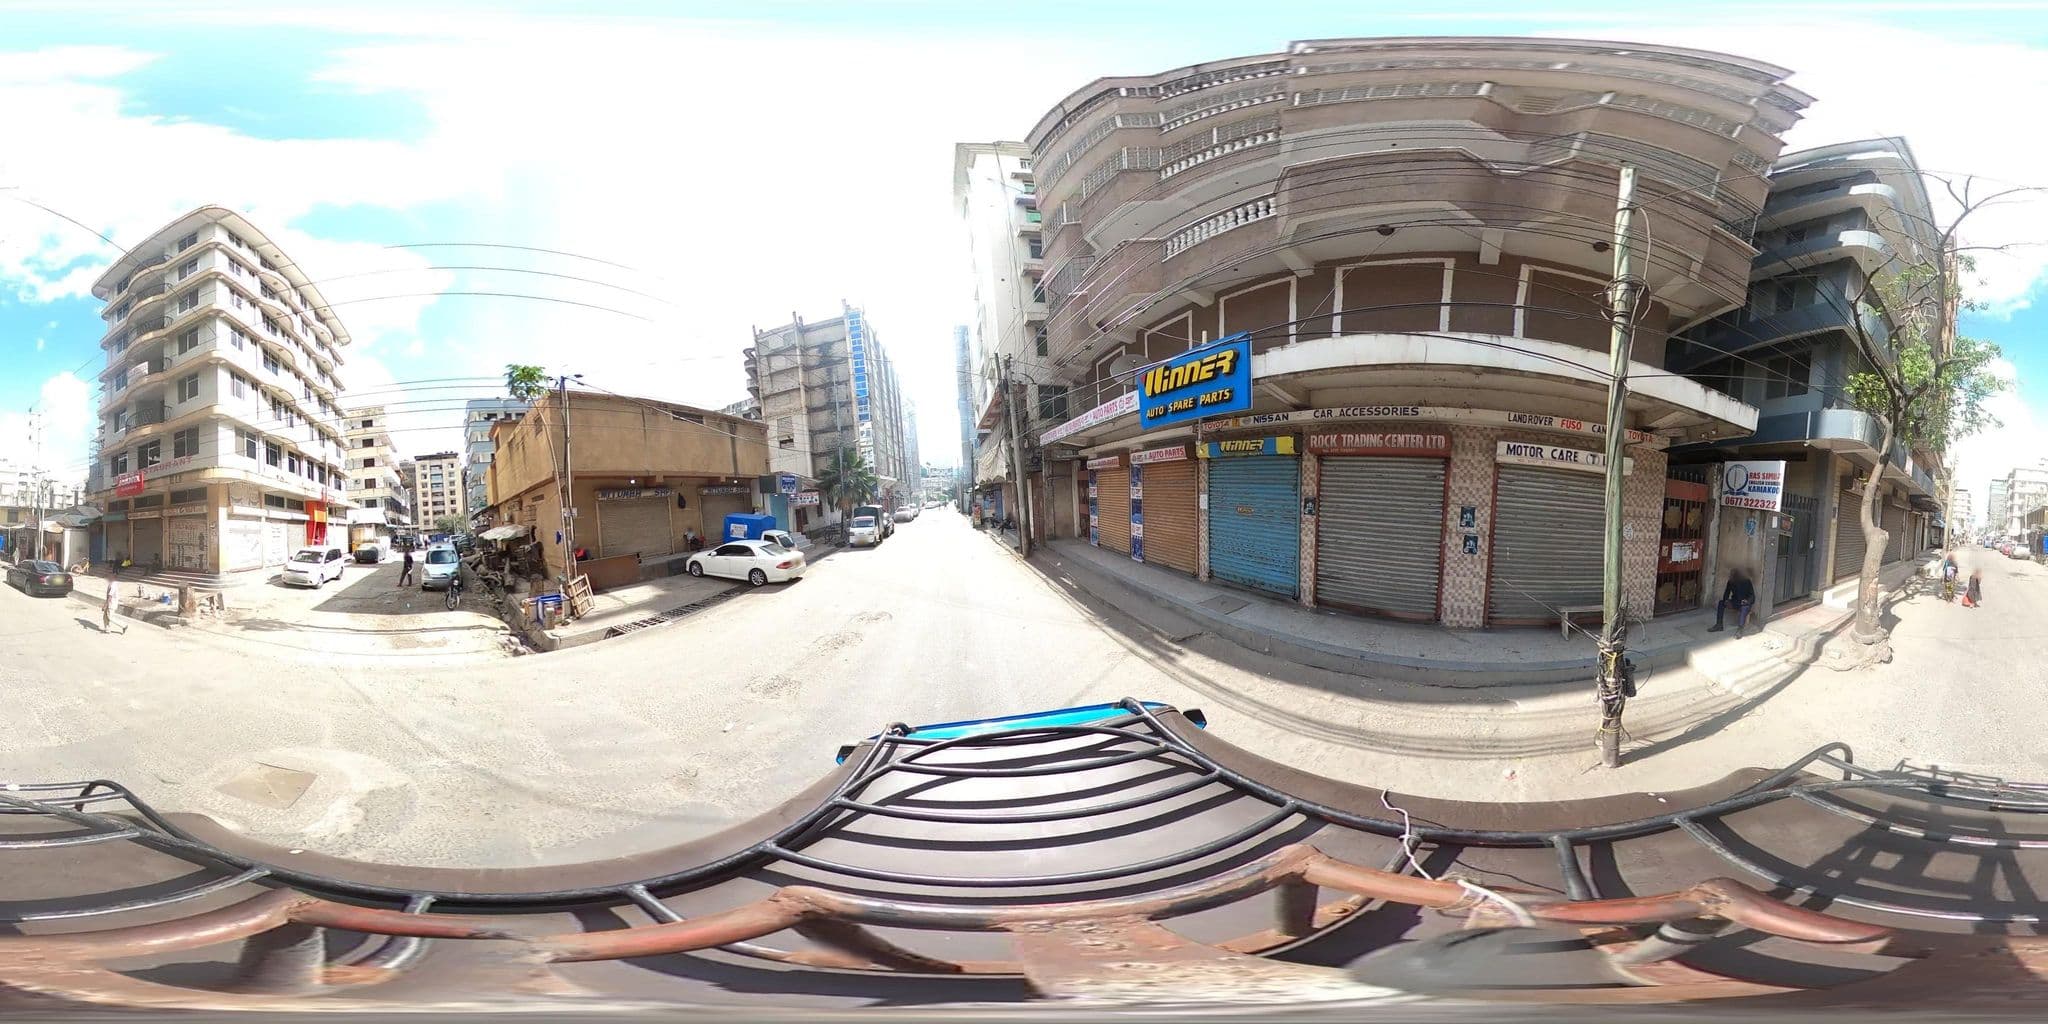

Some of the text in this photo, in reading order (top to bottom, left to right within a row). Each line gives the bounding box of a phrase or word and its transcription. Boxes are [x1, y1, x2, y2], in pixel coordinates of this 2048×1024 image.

[1103, 402, 1118, 415] PARTS
[1146, 388, 1230, 418] AUTO SPARE PARTS
[1253, 413, 1289, 424] NISSAN
[1313, 407, 1419, 418] CAR ACCESSORIES
[1508, 412, 1553, 426] LANDROVER
[1205, 420, 1230, 430] TOYOTA
[1560, 419, 1582, 430] FUSO
[1310, 434, 1446, 449] ROCK TRADING CENTER LTD
[1629, 430, 1654, 443] TOYOTA
[1149, 451, 1163, 460] AUTO
[1164, 447, 1184, 458] PARTS
[1506, 443, 1544, 459] MOTOR
[1551, 448, 1579, 462] CARE
[1744, 498, 1776, 509] 322322
